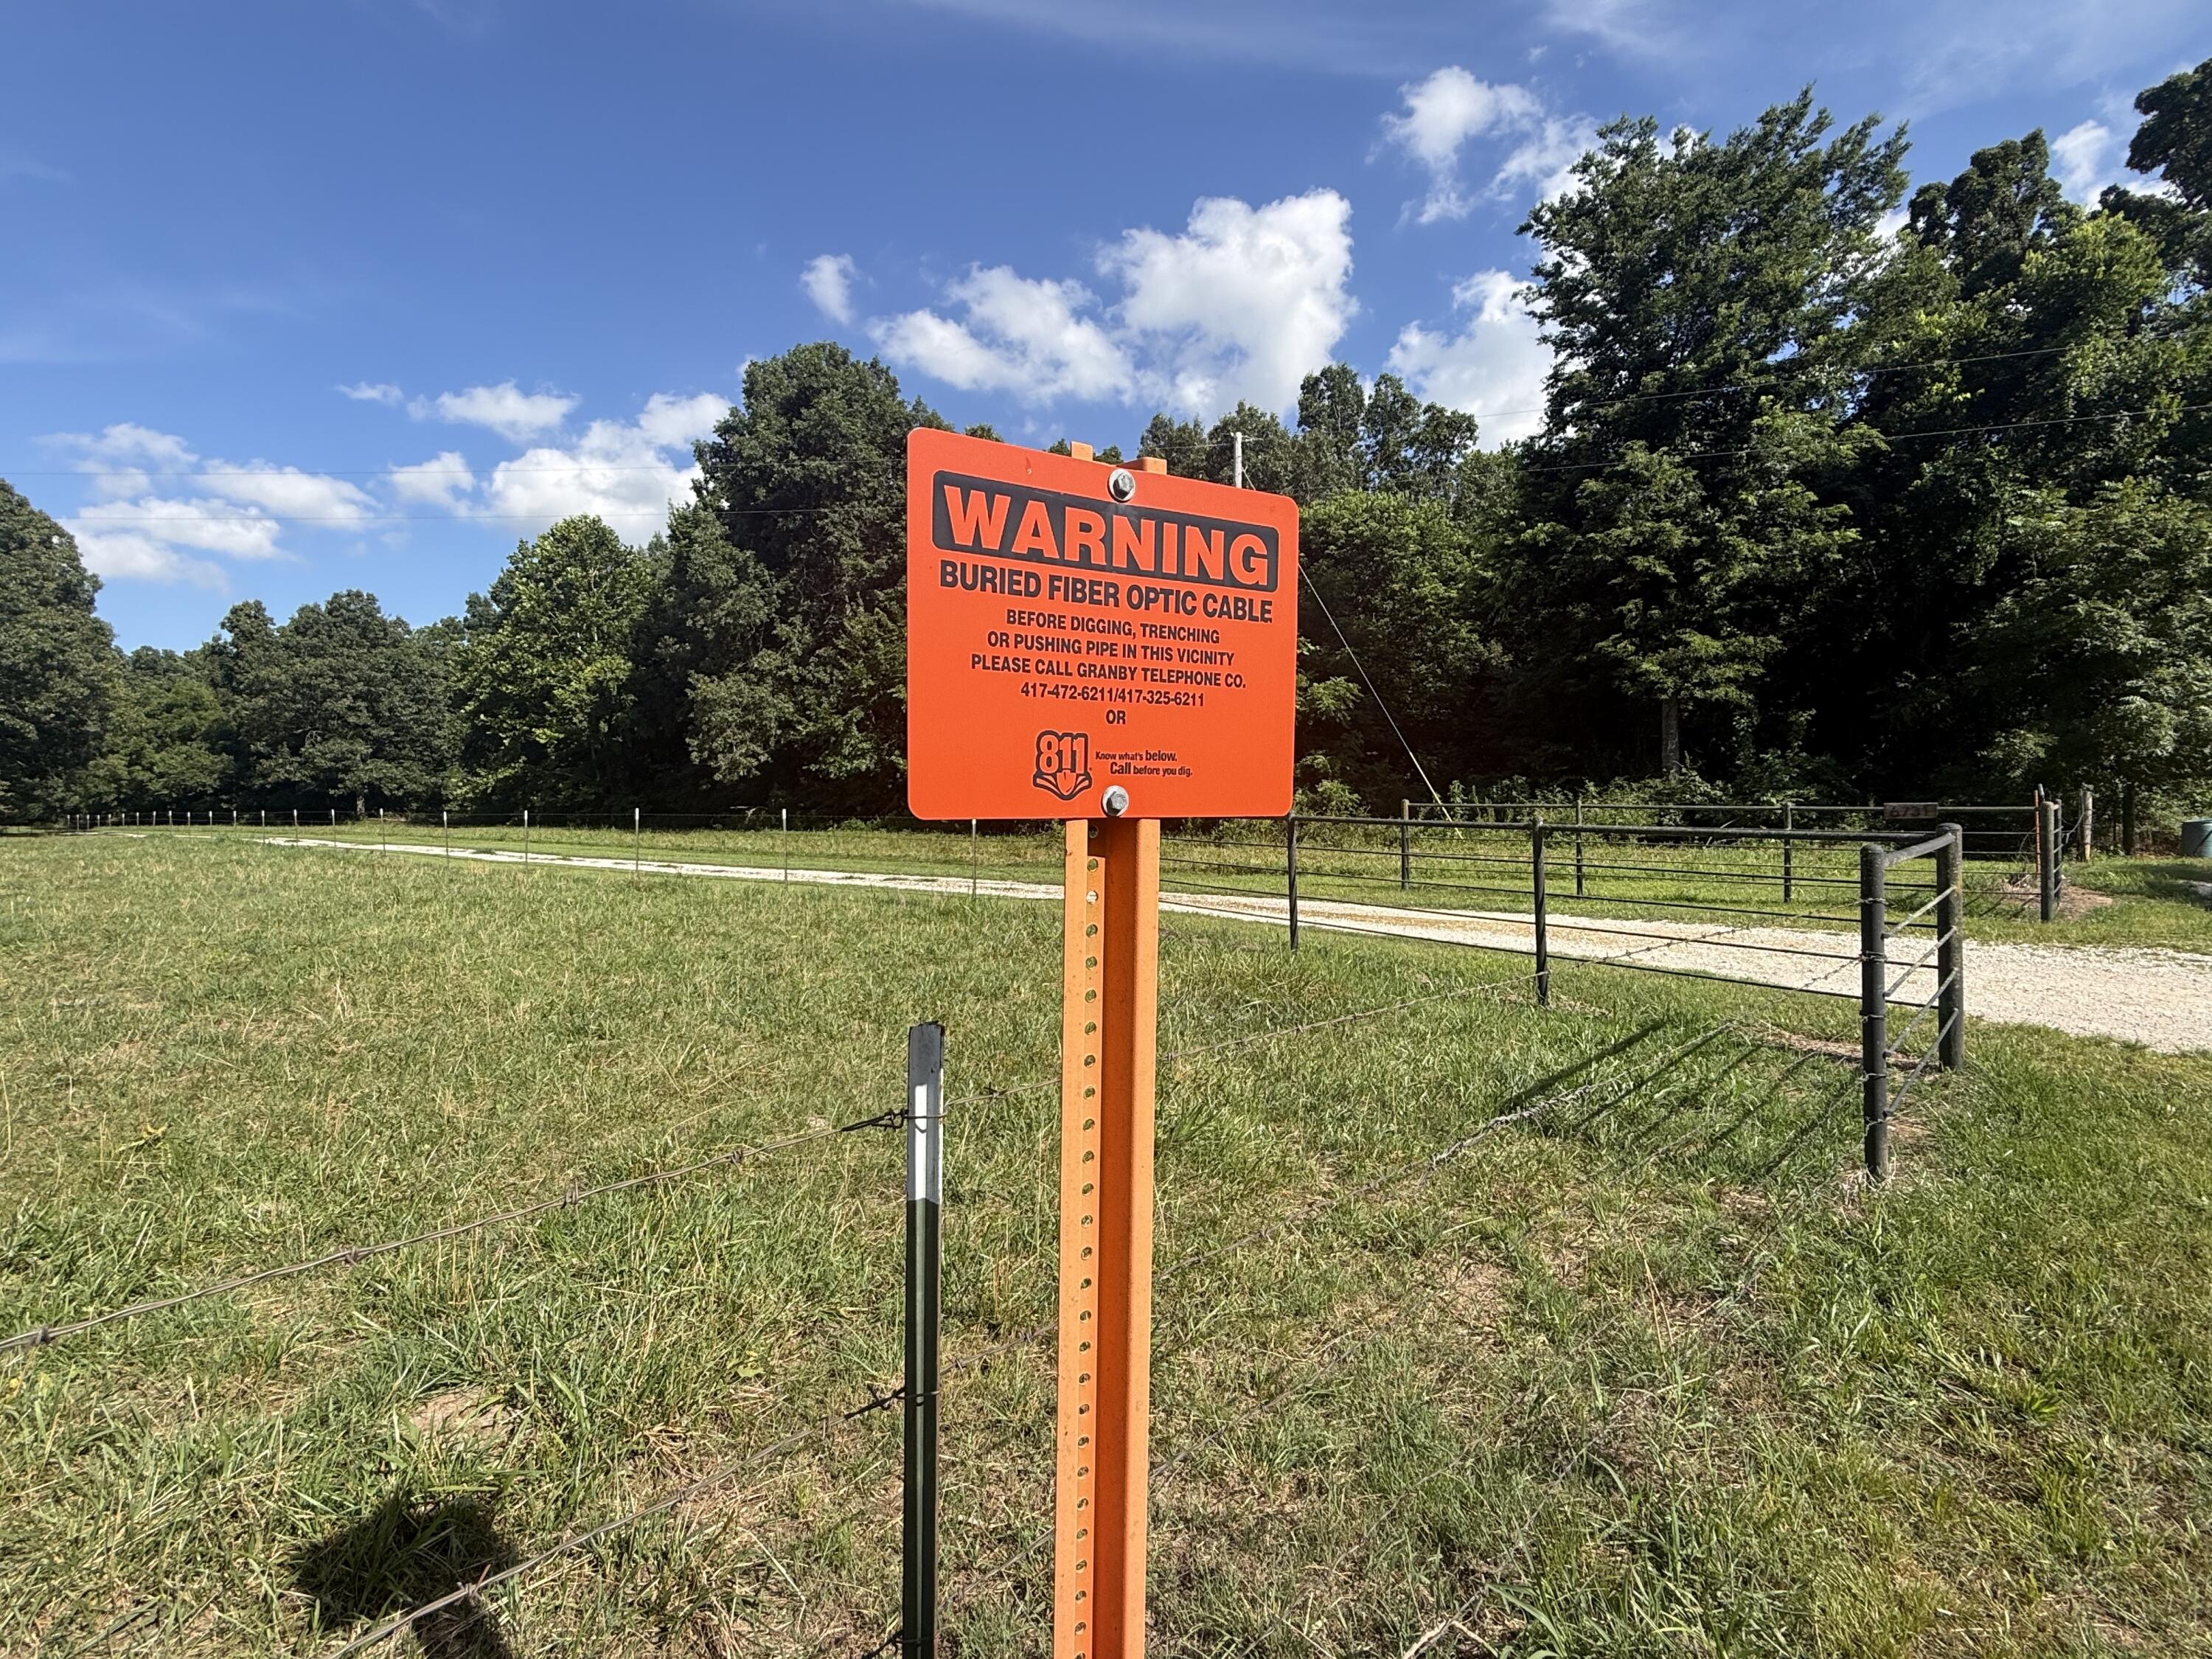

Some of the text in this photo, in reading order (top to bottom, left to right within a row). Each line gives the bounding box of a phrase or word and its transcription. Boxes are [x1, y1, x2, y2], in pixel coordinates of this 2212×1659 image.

[943, 484, 1269, 587] WARNING
[940, 560, 1273, 623] BURIED FIBER OPTIC CABLE
[1006, 608, 1220, 644] BEFORE DIGGING, TRENCHING
[987, 630, 1234, 666] OR PUSHING PIPE IN THIS VICINITY
[971, 653, 1246, 689] PLEASE CALL GRANBY TELEPHONE CO.
[1020, 682, 1204, 706] 417-472-6211/417-325-6211
[1105, 709, 1126, 725] OR
[1038, 734, 1086, 775] 811
[1095, 749, 1178, 762] Know what's below.
[1110, 761, 1193, 778] Call before you dig.
